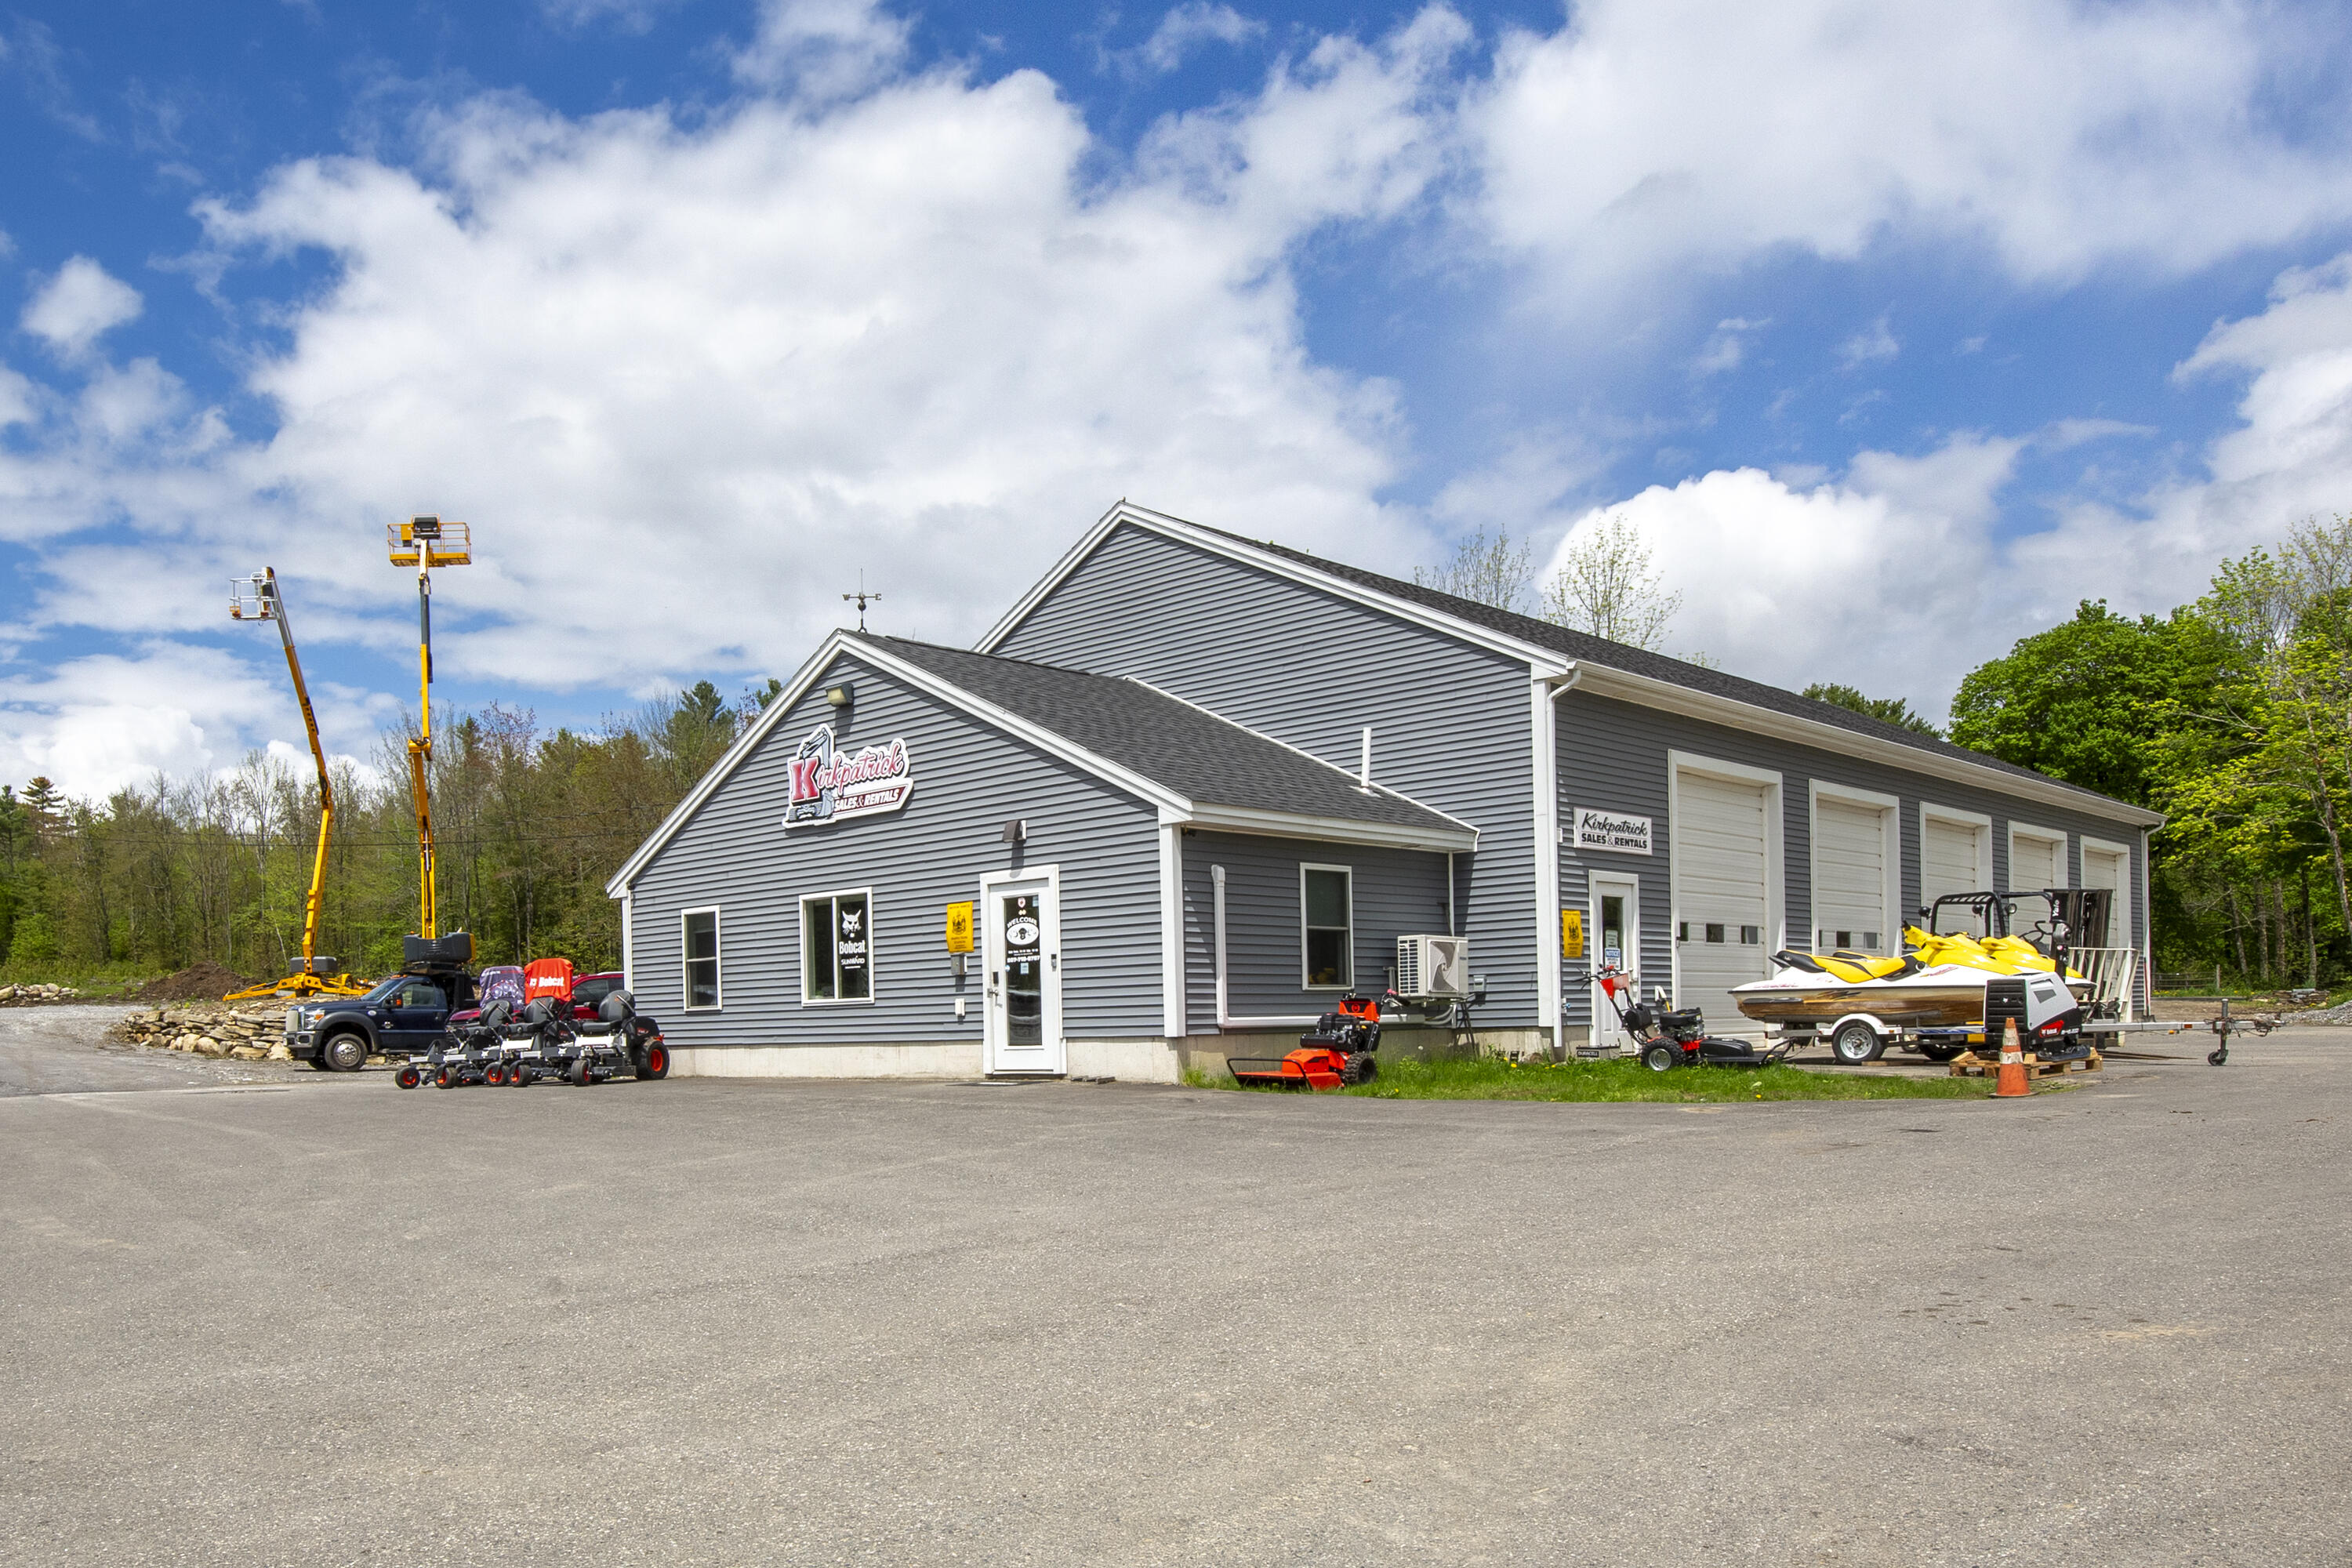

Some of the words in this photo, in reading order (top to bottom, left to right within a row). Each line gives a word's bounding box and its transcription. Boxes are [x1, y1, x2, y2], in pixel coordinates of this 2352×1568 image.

[789, 742, 904, 802] Kirkpatrick
[835, 796, 857, 811] SALES
[864, 788, 900, 807] RENTALS
[1581, 812, 1648, 837] Kirkpatrick
[1581, 833, 1606, 844] SALES
[1615, 837, 1647, 849] RENTALS
[839, 939, 866, 955] Bobcat
